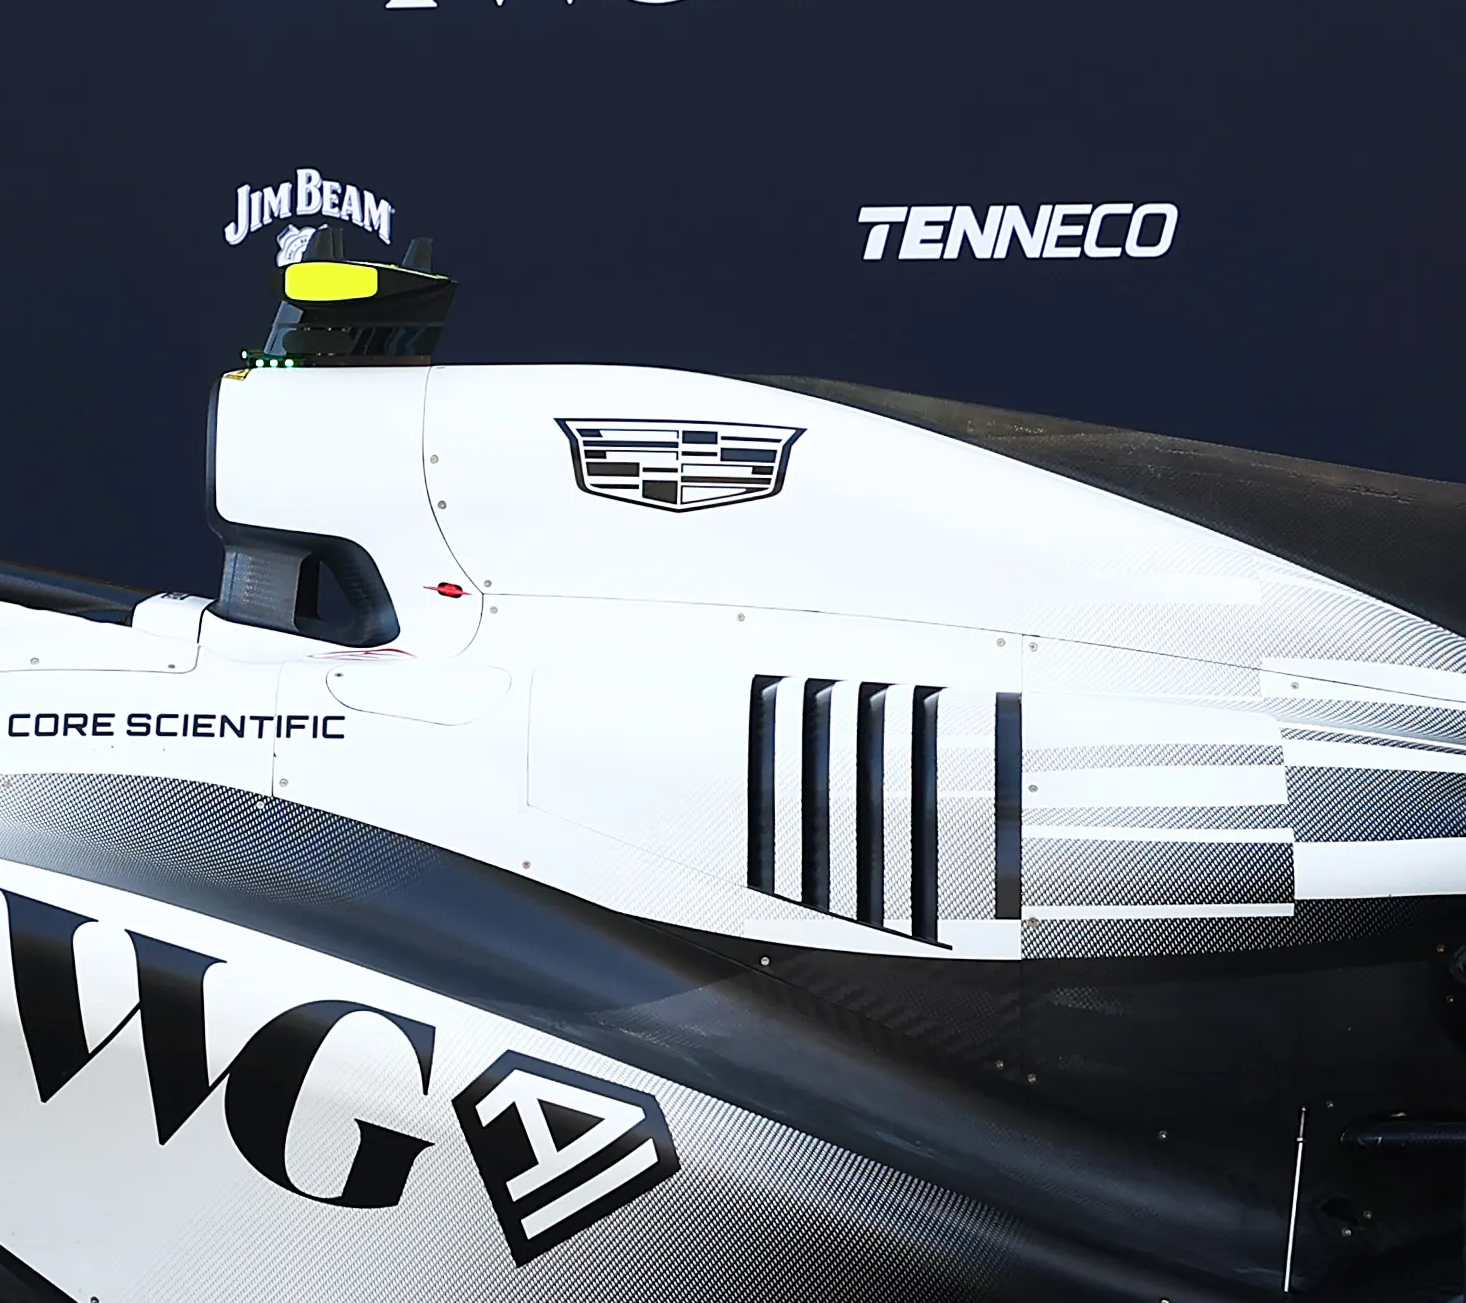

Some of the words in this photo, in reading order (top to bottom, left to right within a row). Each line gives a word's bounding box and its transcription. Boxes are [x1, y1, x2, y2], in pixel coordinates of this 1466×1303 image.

[223, 182, 293, 245] JIM
[295, 167, 392, 245] BEAM
[857, 202, 1179, 260] TENNECO
[8, 713, 118, 740] CORE
[126, 713, 345, 741] SCIENTIFIC
